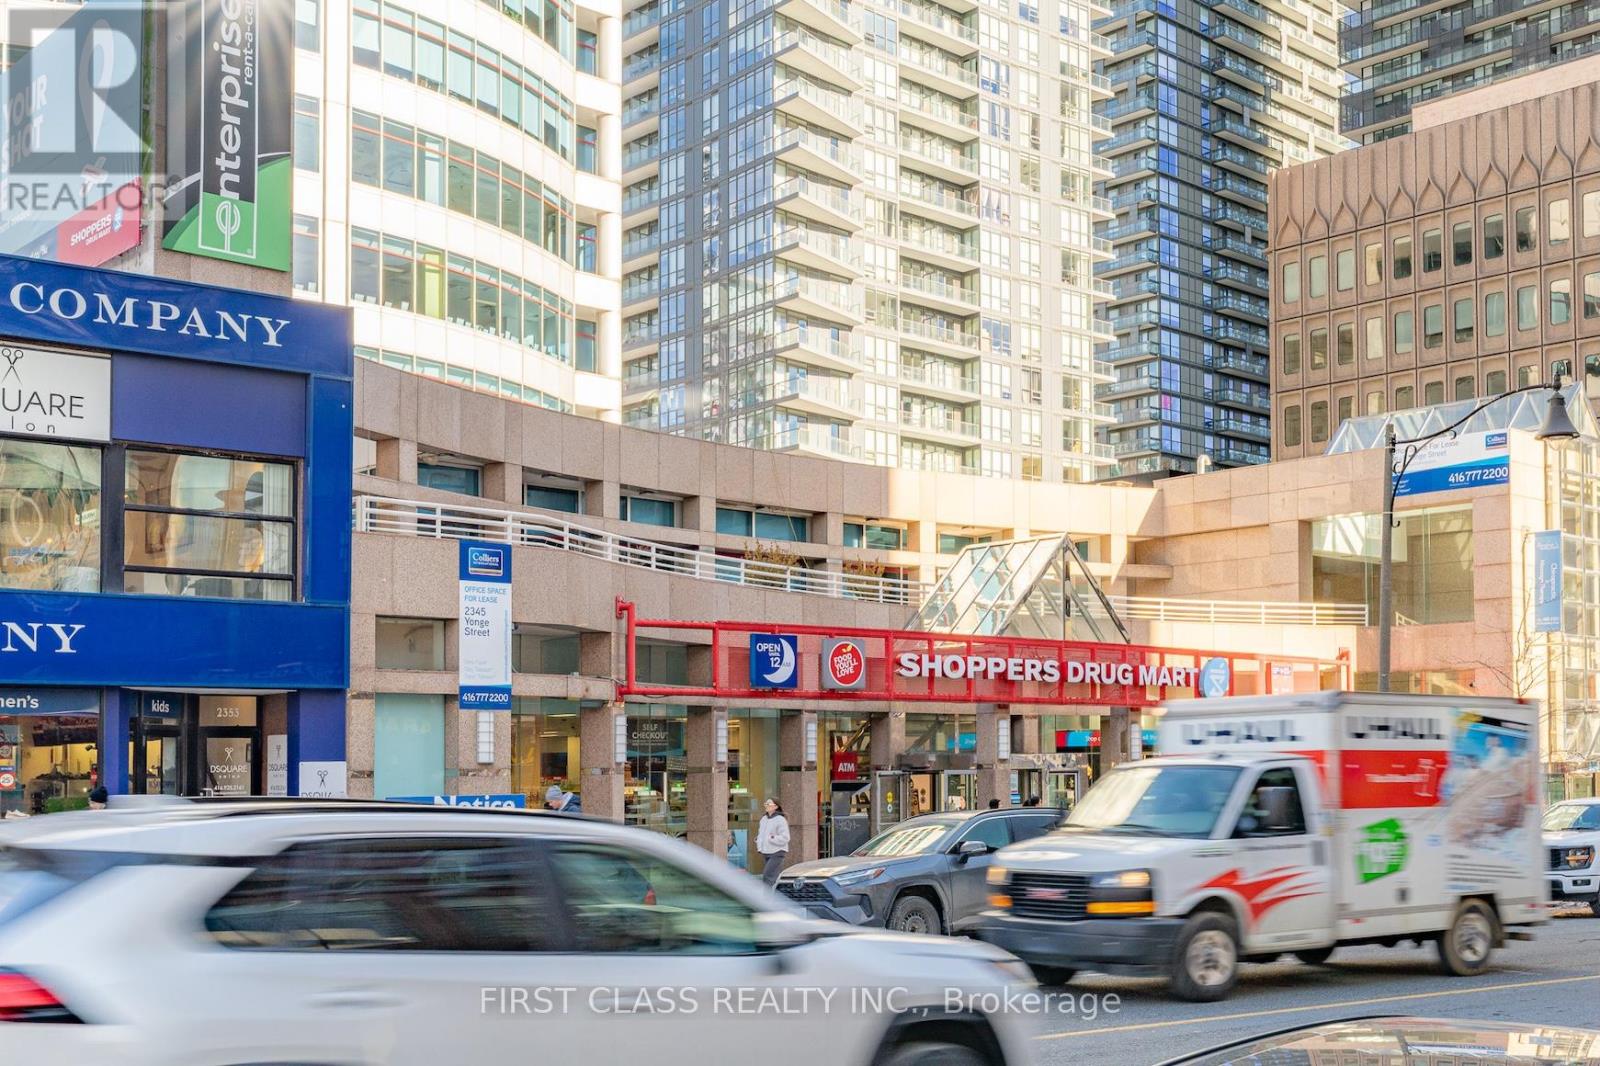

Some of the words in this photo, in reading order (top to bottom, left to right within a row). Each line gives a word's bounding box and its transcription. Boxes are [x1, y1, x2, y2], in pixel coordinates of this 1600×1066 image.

[70, 213, 112, 247] SHOPPERS
[9, 282, 291, 347] COMPANY
[472, 552, 500, 563] Colliers
[464, 585, 486, 594] OFFICE
[487, 587, 507, 595] SPACE
[464, 594, 477, 602] FOR
[478, 596, 498, 604] LEASE
[464, 606, 486, 616] 2345
[464, 616, 490, 629] Yonge
[464, 626, 490, 636] Street
[1, 622, 85, 653] NY
[756, 643, 781, 653] OPEN
[769, 656, 780, 668] 12
[834, 652, 853, 664] FOOD
[836, 667, 855, 678] LOVE
[898, 652, 1060, 683] SHOPPERS
[1067, 661, 1133, 685] DRUG
[1137, 665, 1199, 688] MART
[151, 700, 170, 713] kids
[642, 723, 658, 731] SELF
[210, 764, 248, 774] DSQUARE
[838, 762, 855, 773] ATM
